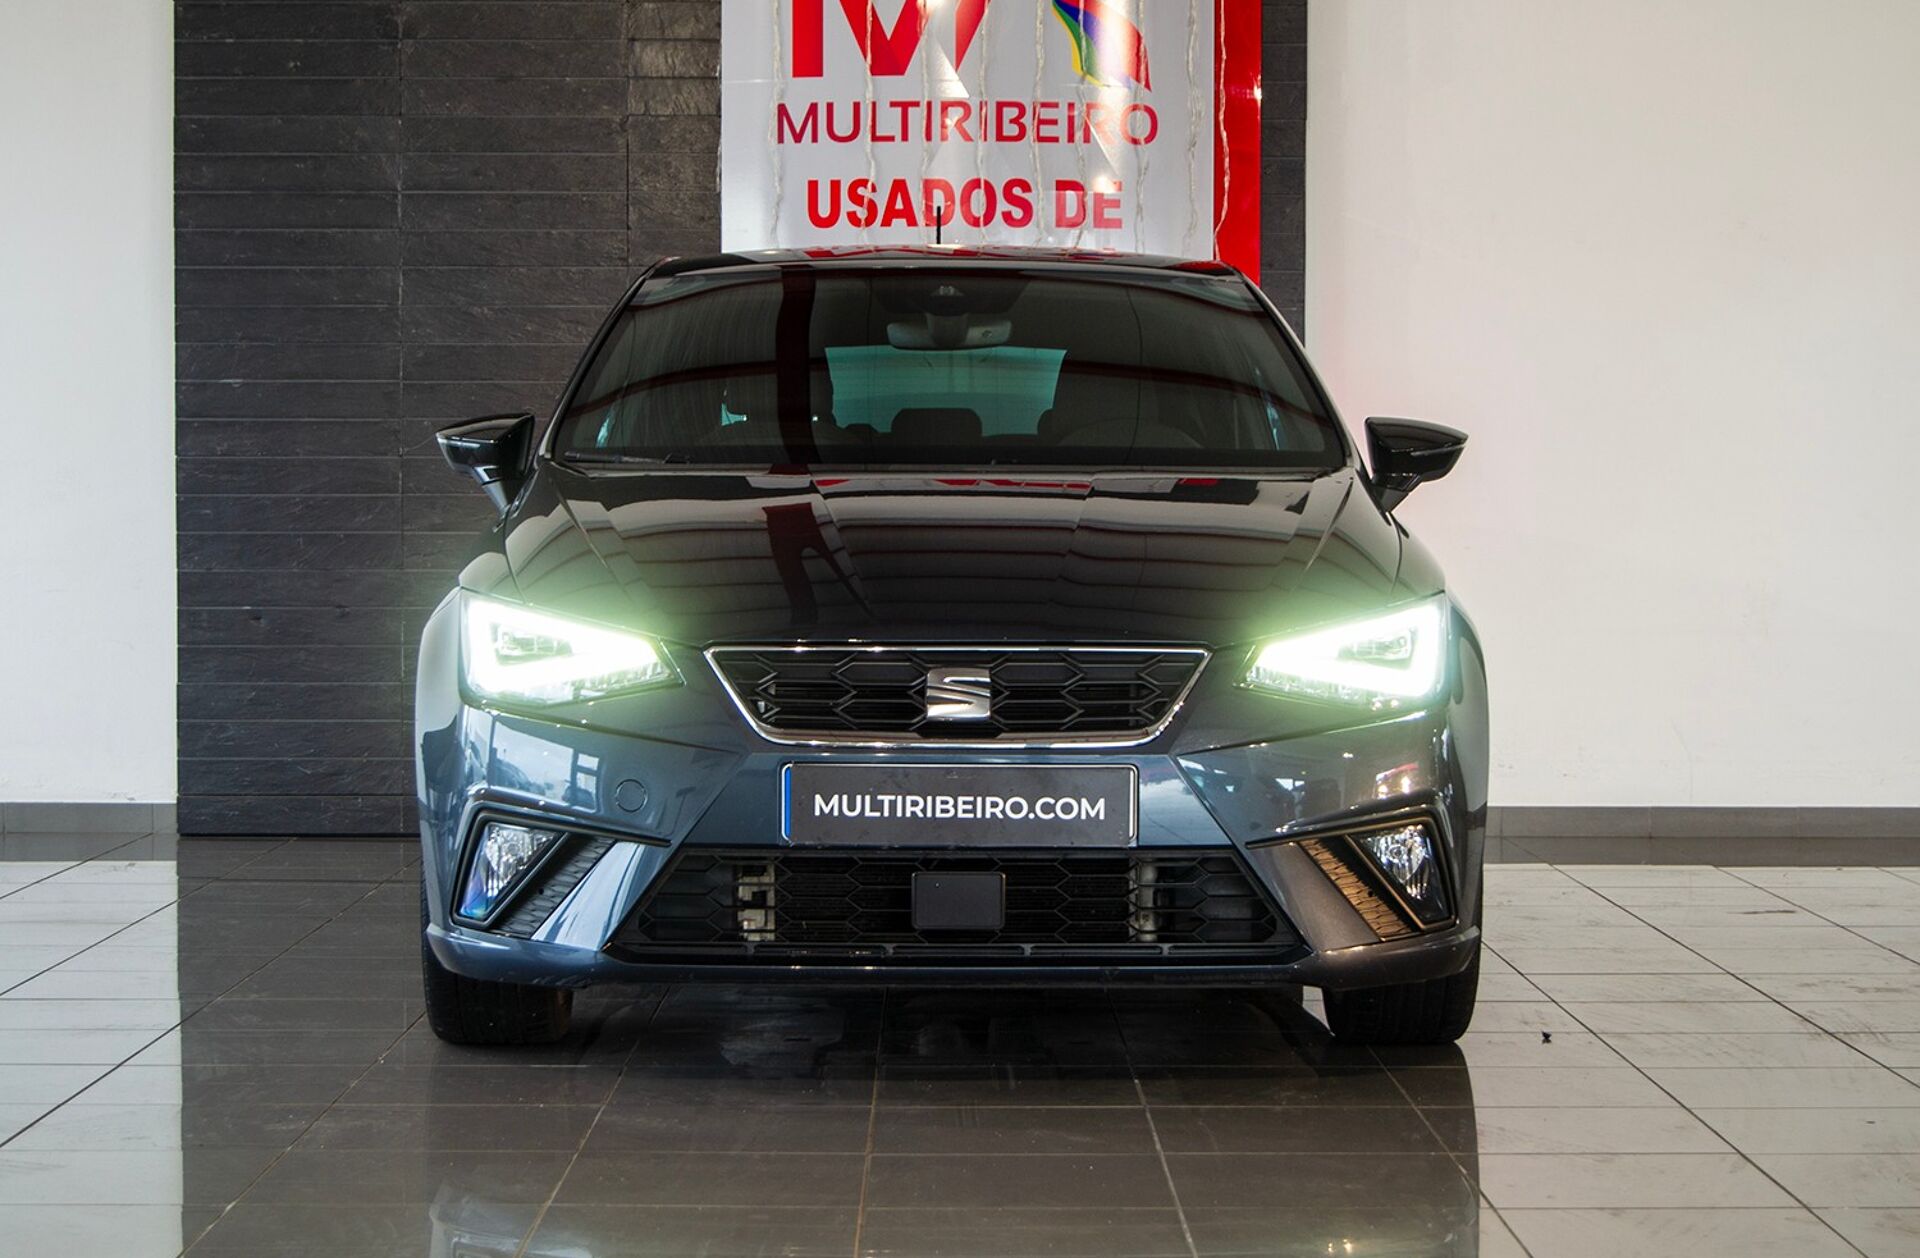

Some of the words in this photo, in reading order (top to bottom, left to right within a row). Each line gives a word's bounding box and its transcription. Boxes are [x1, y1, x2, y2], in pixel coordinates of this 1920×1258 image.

[776, 99, 1159, 147] MULTIRIBEIRO
[807, 178, 1035, 230] USADOS
[1055, 178, 1123, 230] DE
[813, 793, 1106, 820] MULTIRIBEIRO.COM
